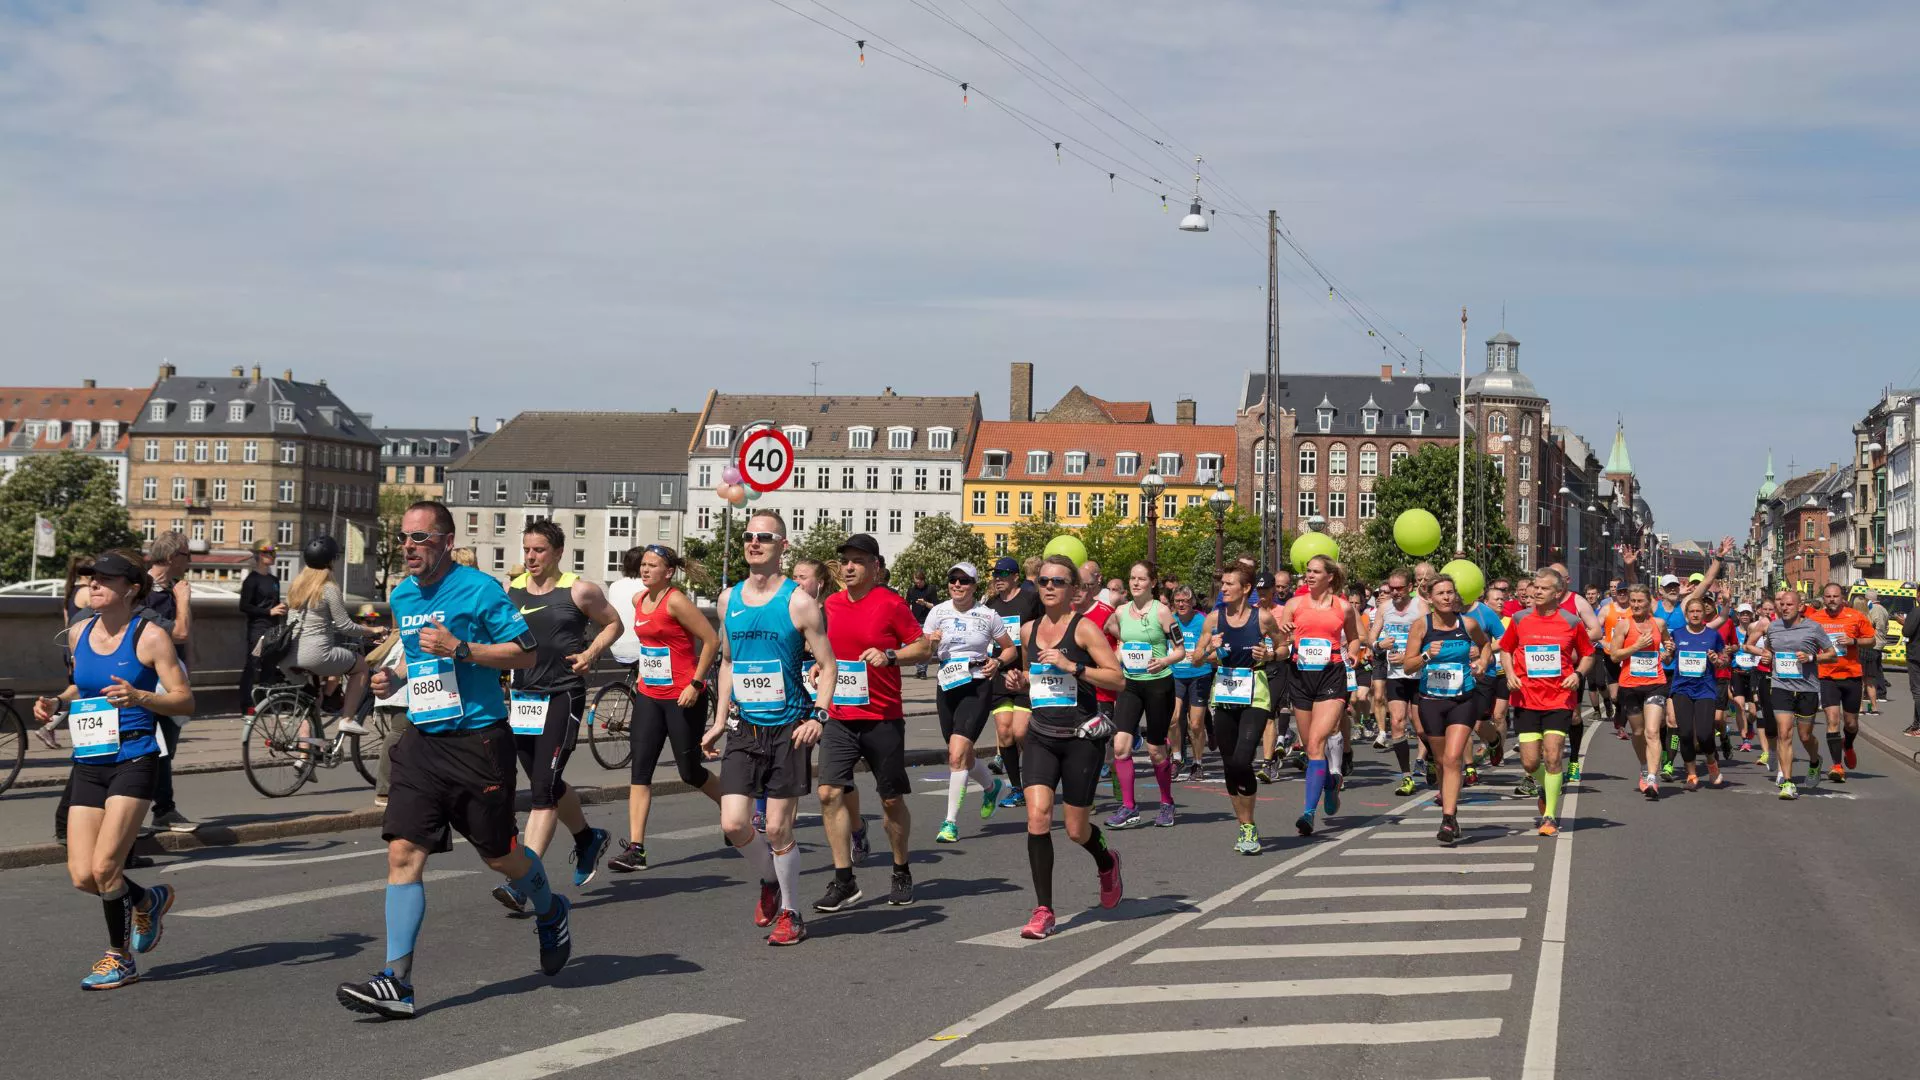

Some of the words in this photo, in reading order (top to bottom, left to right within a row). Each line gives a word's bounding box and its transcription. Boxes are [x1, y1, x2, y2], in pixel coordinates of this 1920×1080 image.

[748, 449, 783, 472] 40
[401, 628, 420, 636] ener
[732, 630, 779, 640] SPARTA
[1127, 652, 1144, 660] 1901
[1305, 648, 1323, 656] 1902
[1531, 654, 1556, 662] 10035
[942, 663, 963, 675] 10515
[743, 677, 771, 688] 9192
[838, 675, 857, 685] 583
[1222, 678, 1243, 687] 5617
[413, 679, 443, 695] 6880
[517, 705, 543, 716] 10743
[77, 716, 103, 730] 1734
